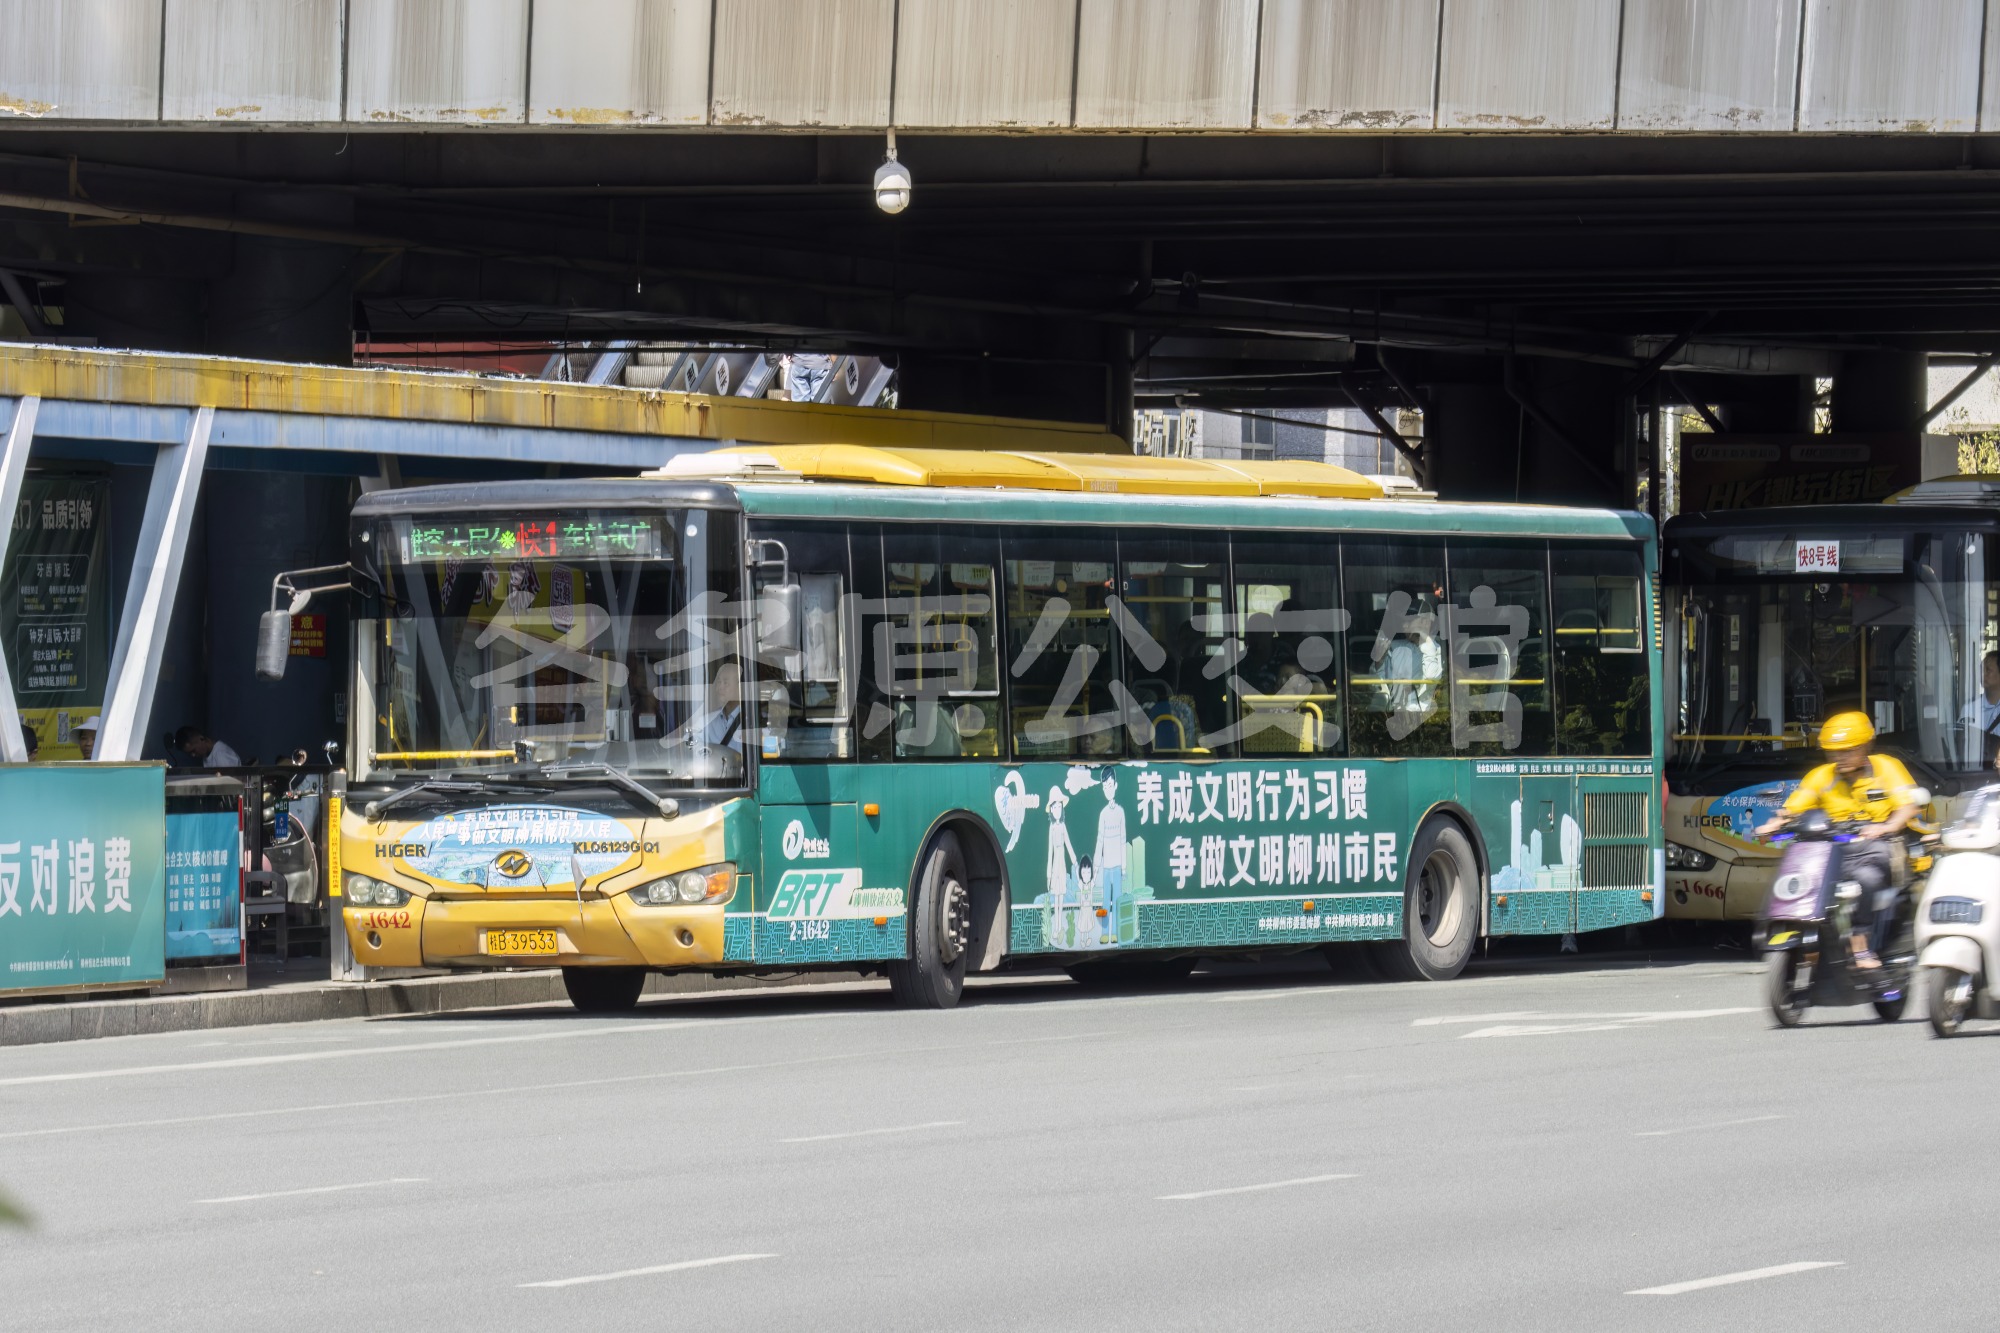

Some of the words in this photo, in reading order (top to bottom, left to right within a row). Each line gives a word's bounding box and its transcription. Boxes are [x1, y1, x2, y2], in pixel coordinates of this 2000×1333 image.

[42, 499, 93, 530] 品质引领
[516, 521, 557, 557] 快1
[1798, 545, 1838, 567] 快8号线
[1136, 768, 1368, 825] 养成文明行为习惯
[1684, 815, 1732, 828] HIGER
[375, 843, 426, 858] HIGER
[1169, 832, 1398, 890] 争做文明柳州市民
[0, 837, 132, 917] 反对浪费
[769, 873, 845, 917] BRT
[853, 891, 901, 907] 柳州快速公交
[789, 920, 830, 941] 2-1642
[1258, 915, 1321, 930] 中共柳州市委宣传部
